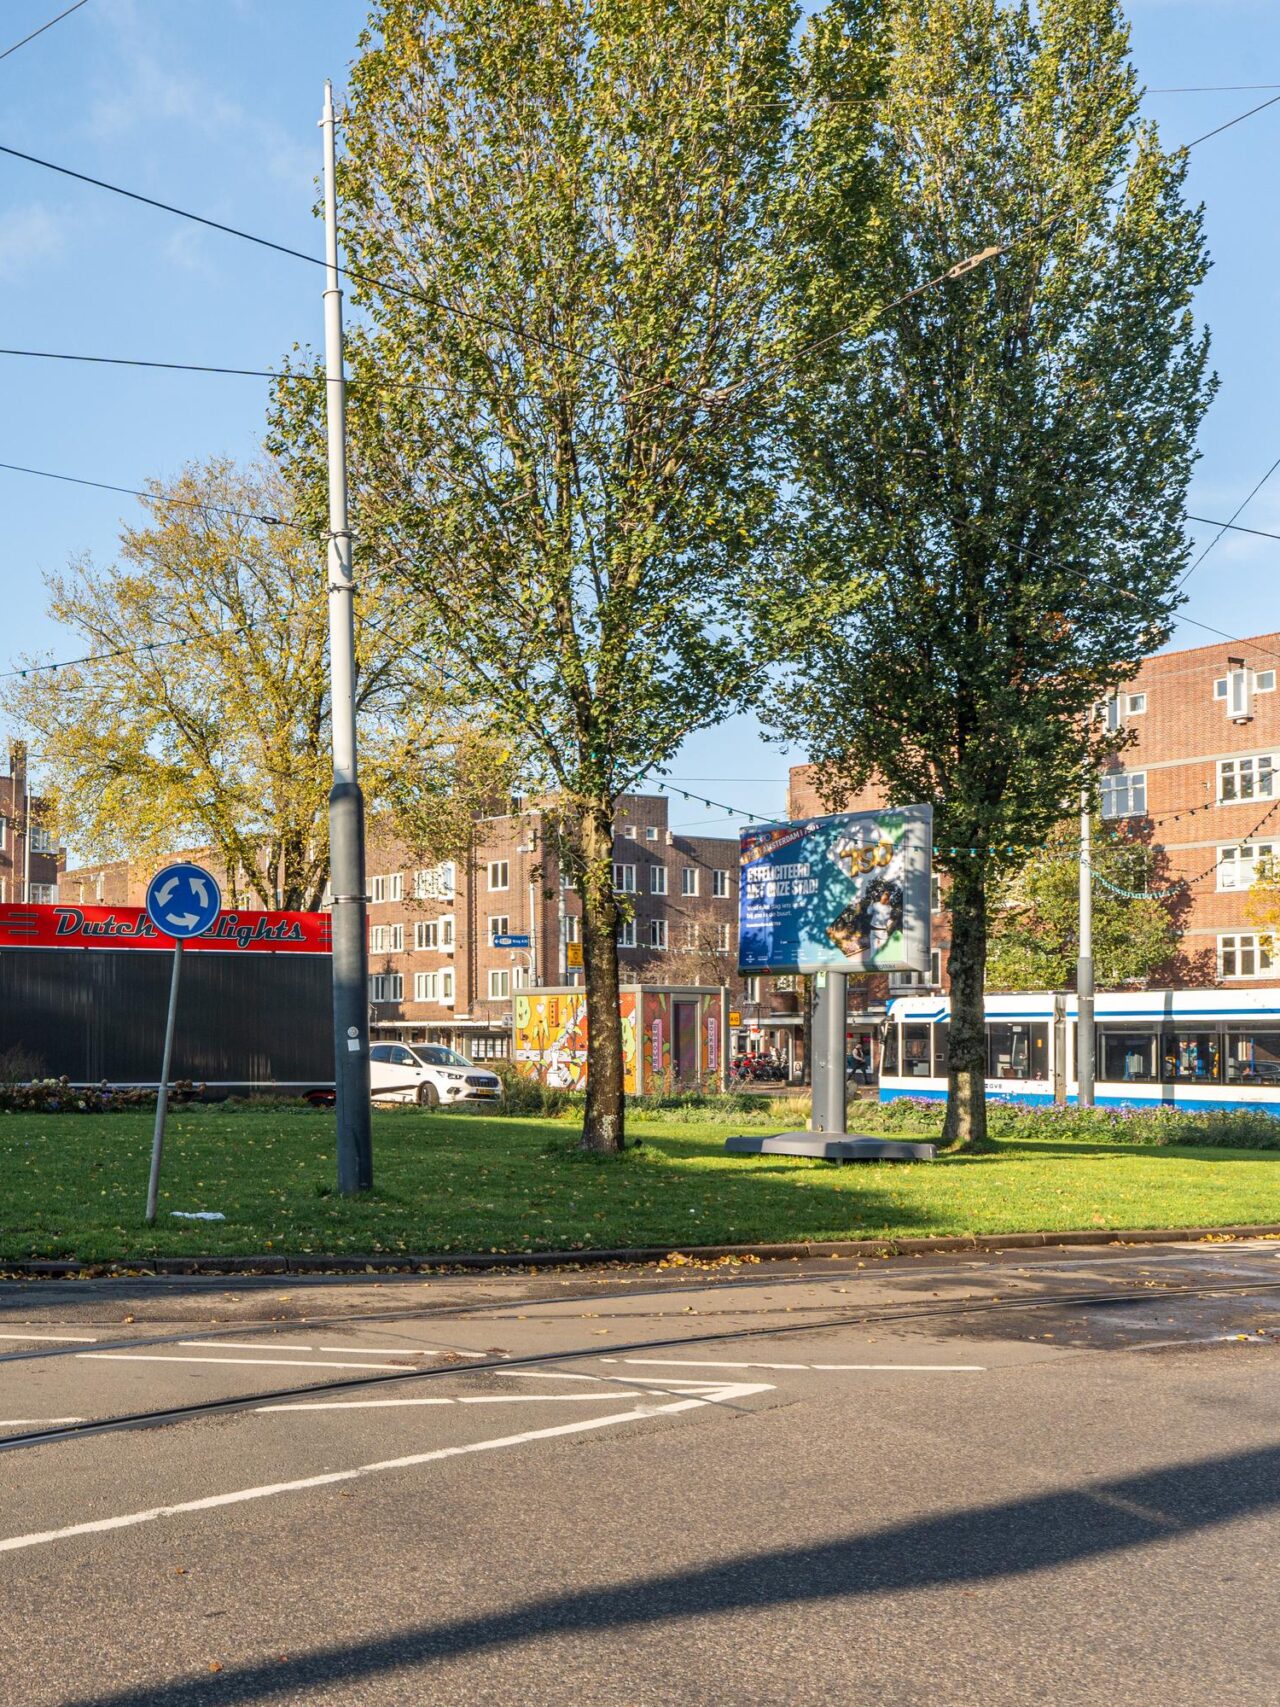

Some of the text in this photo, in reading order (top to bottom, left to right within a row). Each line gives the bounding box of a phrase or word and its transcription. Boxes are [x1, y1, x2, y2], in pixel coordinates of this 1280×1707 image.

[791, 878, 819, 895] STAD!
[53, 908, 307, 949] Dutch lights
